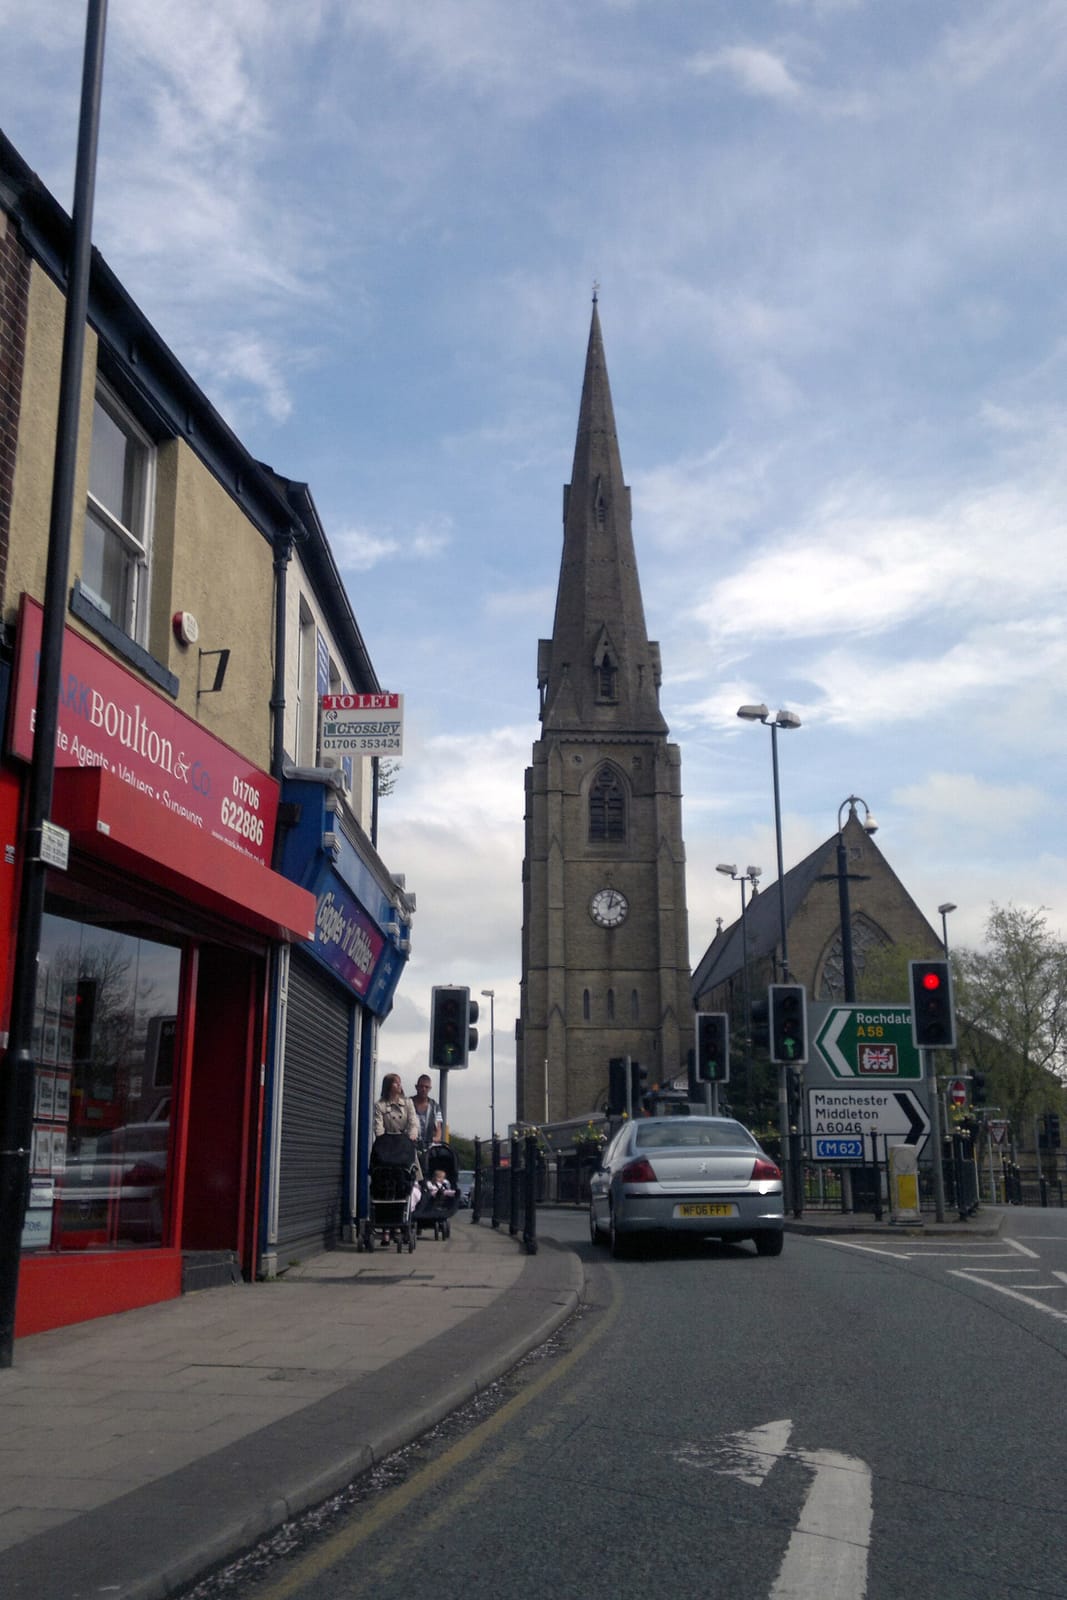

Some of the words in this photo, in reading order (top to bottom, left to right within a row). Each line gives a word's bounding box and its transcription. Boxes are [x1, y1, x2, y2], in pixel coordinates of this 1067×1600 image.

[328, 695, 354, 708] TO
[360, 694, 393, 708] LET
[337, 722, 400, 736] Crossley
[324, 740, 357, 749] 01706
[360, 738, 400, 748] 353424
[70, 735, 109, 770] Agents
[232, 775, 260, 810] 01706
[221, 796, 264, 846] 622886
[856, 1026, 884, 1037] A58
[815, 1094, 888, 1106] Manchester
[815, 1108, 878, 1120] Middleton
[816, 1122, 862, 1133] A6046
[818, 1141, 862, 1156] (M62)
